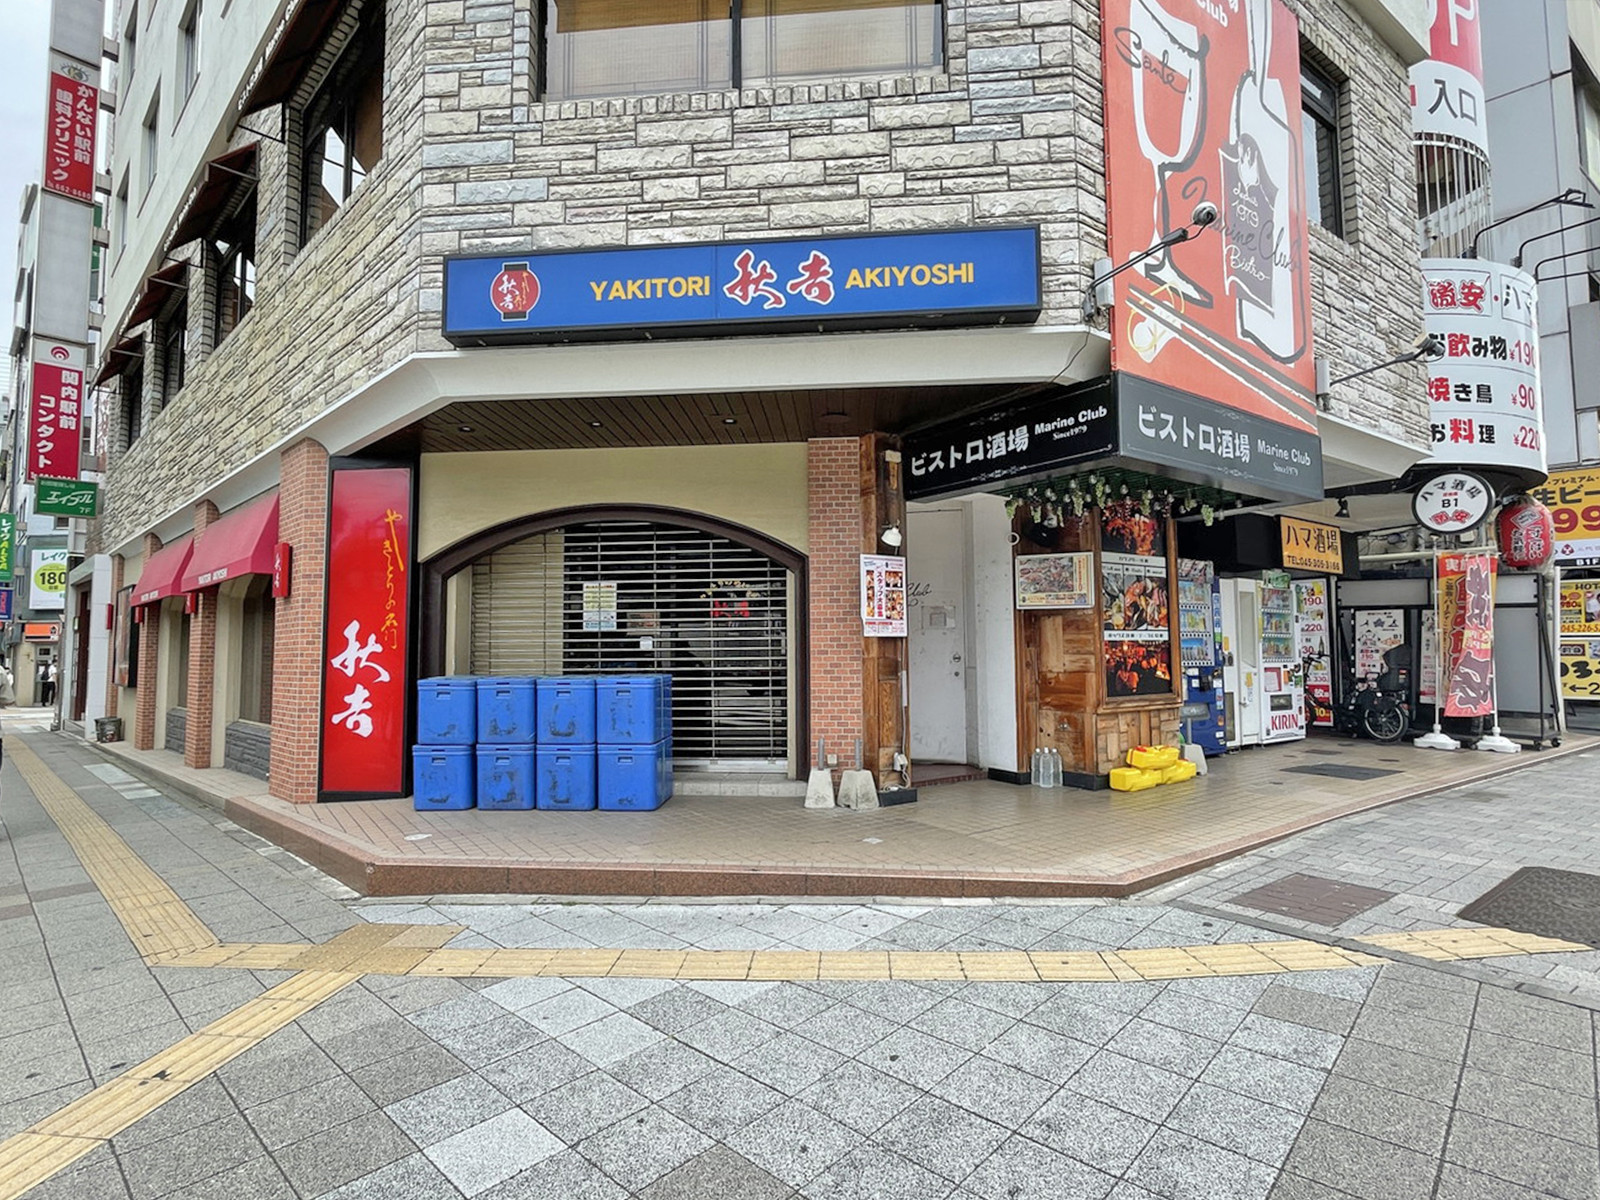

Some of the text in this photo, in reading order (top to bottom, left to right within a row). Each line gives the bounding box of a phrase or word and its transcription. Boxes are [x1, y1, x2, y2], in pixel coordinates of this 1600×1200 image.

[1428, 79, 1477, 126] 入口
[75, 85, 94, 165] かんない駅前
[590, 276, 710, 301] YAKITORI
[845, 263, 974, 289] AKIYOSHI
[1428, 280, 1484, 312] 激安
[59, 370, 79, 431] 関内駅前
[36, 394, 56, 469] コンタクト
[911, 405, 1107, 477] ビストロ酒場 Marine Club
[1138, 404, 1311, 466] ビストロ酒場 Marine Club
[1430, 418, 1495, 444] お料理
[1421, 479, 1482, 502] ハマ酒場
[1553, 475, 1595, 486] プレミアム
[40, 490, 94, 506] エイブル
[1441, 498, 1458, 508] B1
[1286, 525, 1339, 556] ハマ酒場
[1305, 624, 1322, 632] 220
[1271, 714, 1298, 731] KIRIN
